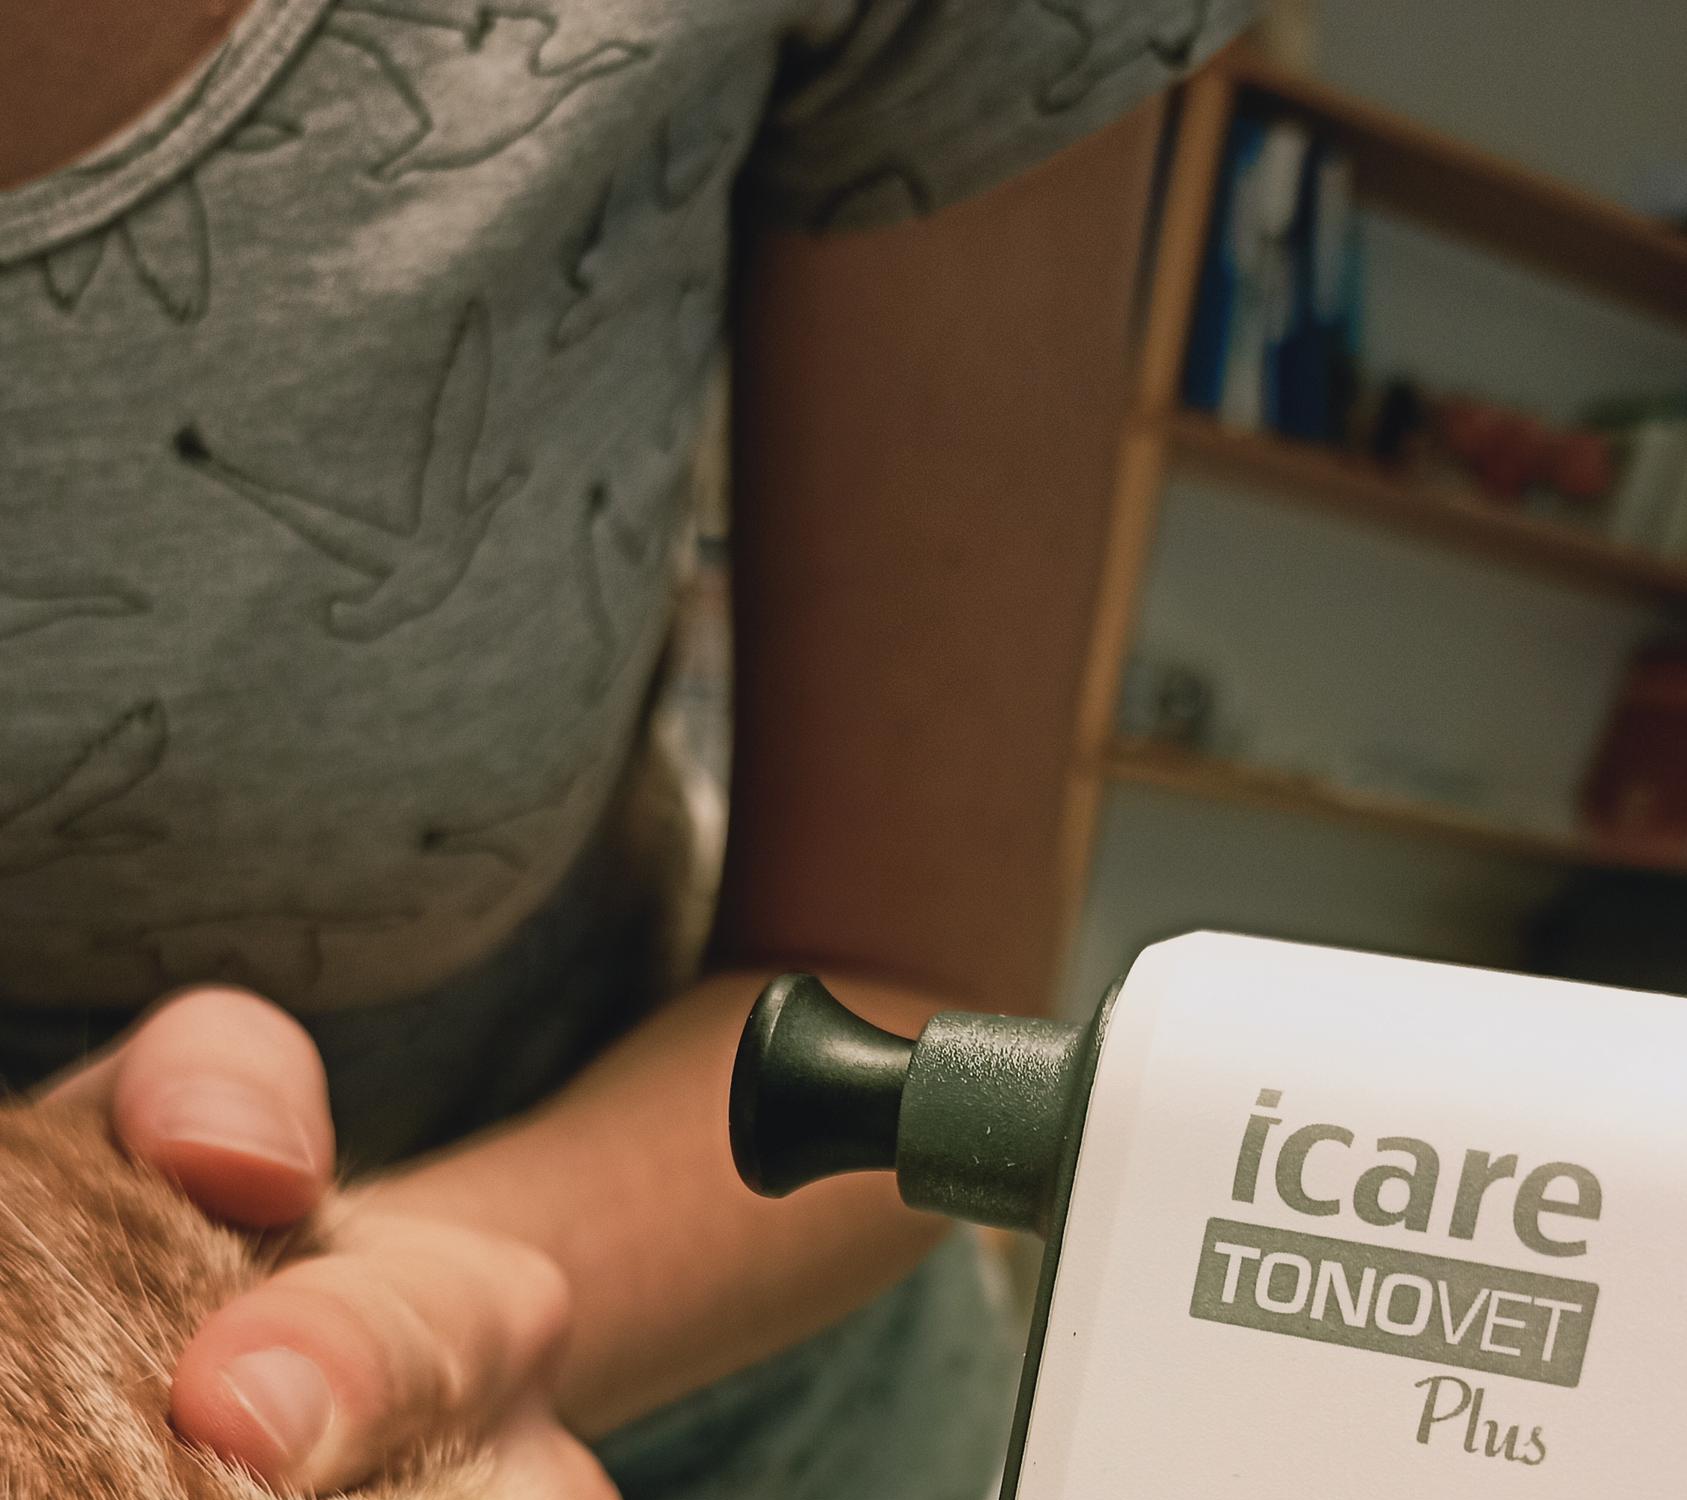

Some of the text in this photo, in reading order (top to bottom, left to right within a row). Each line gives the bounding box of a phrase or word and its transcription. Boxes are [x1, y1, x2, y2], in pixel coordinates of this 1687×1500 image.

[1231, 1088, 1602, 1258] icare
[1214, 1241, 1582, 1363] TONOVET
[1414, 1375, 1547, 1466] Plus
